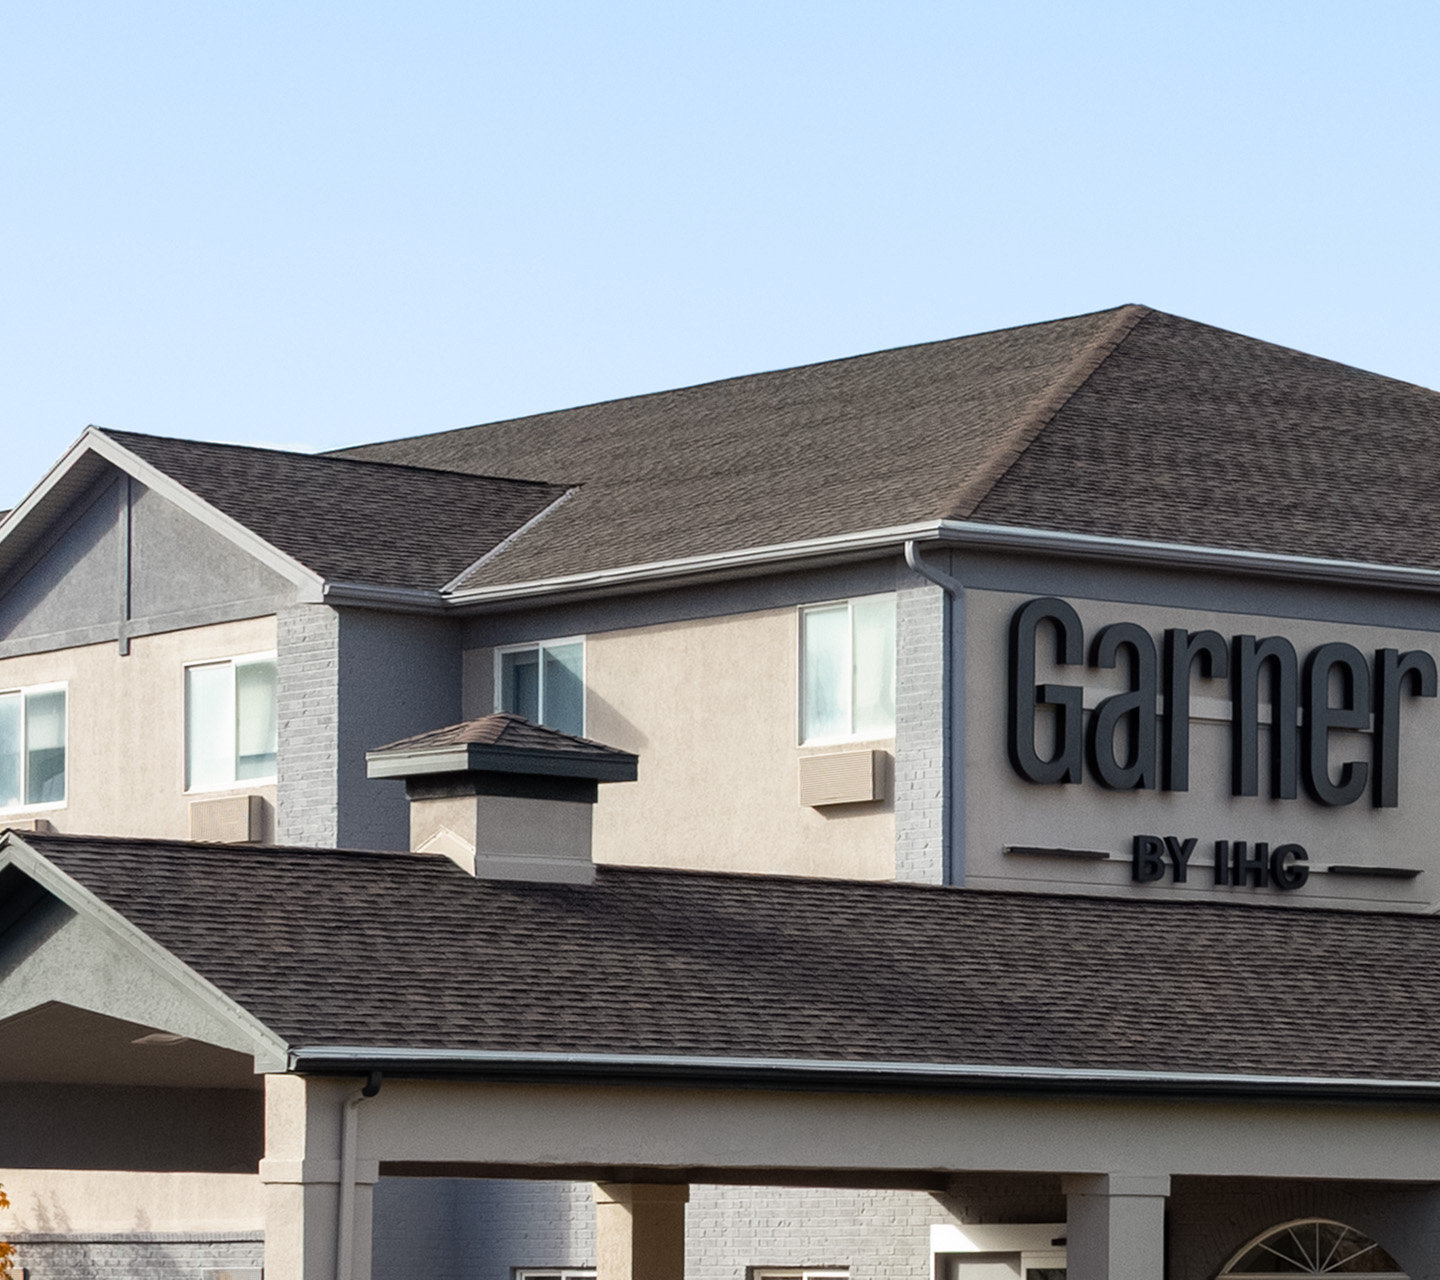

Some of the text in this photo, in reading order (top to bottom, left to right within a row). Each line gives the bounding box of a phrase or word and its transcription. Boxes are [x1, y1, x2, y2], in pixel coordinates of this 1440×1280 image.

[1007, 597, 1438, 809] Garner
[1132, 834, 1309, 890] BY IHG
